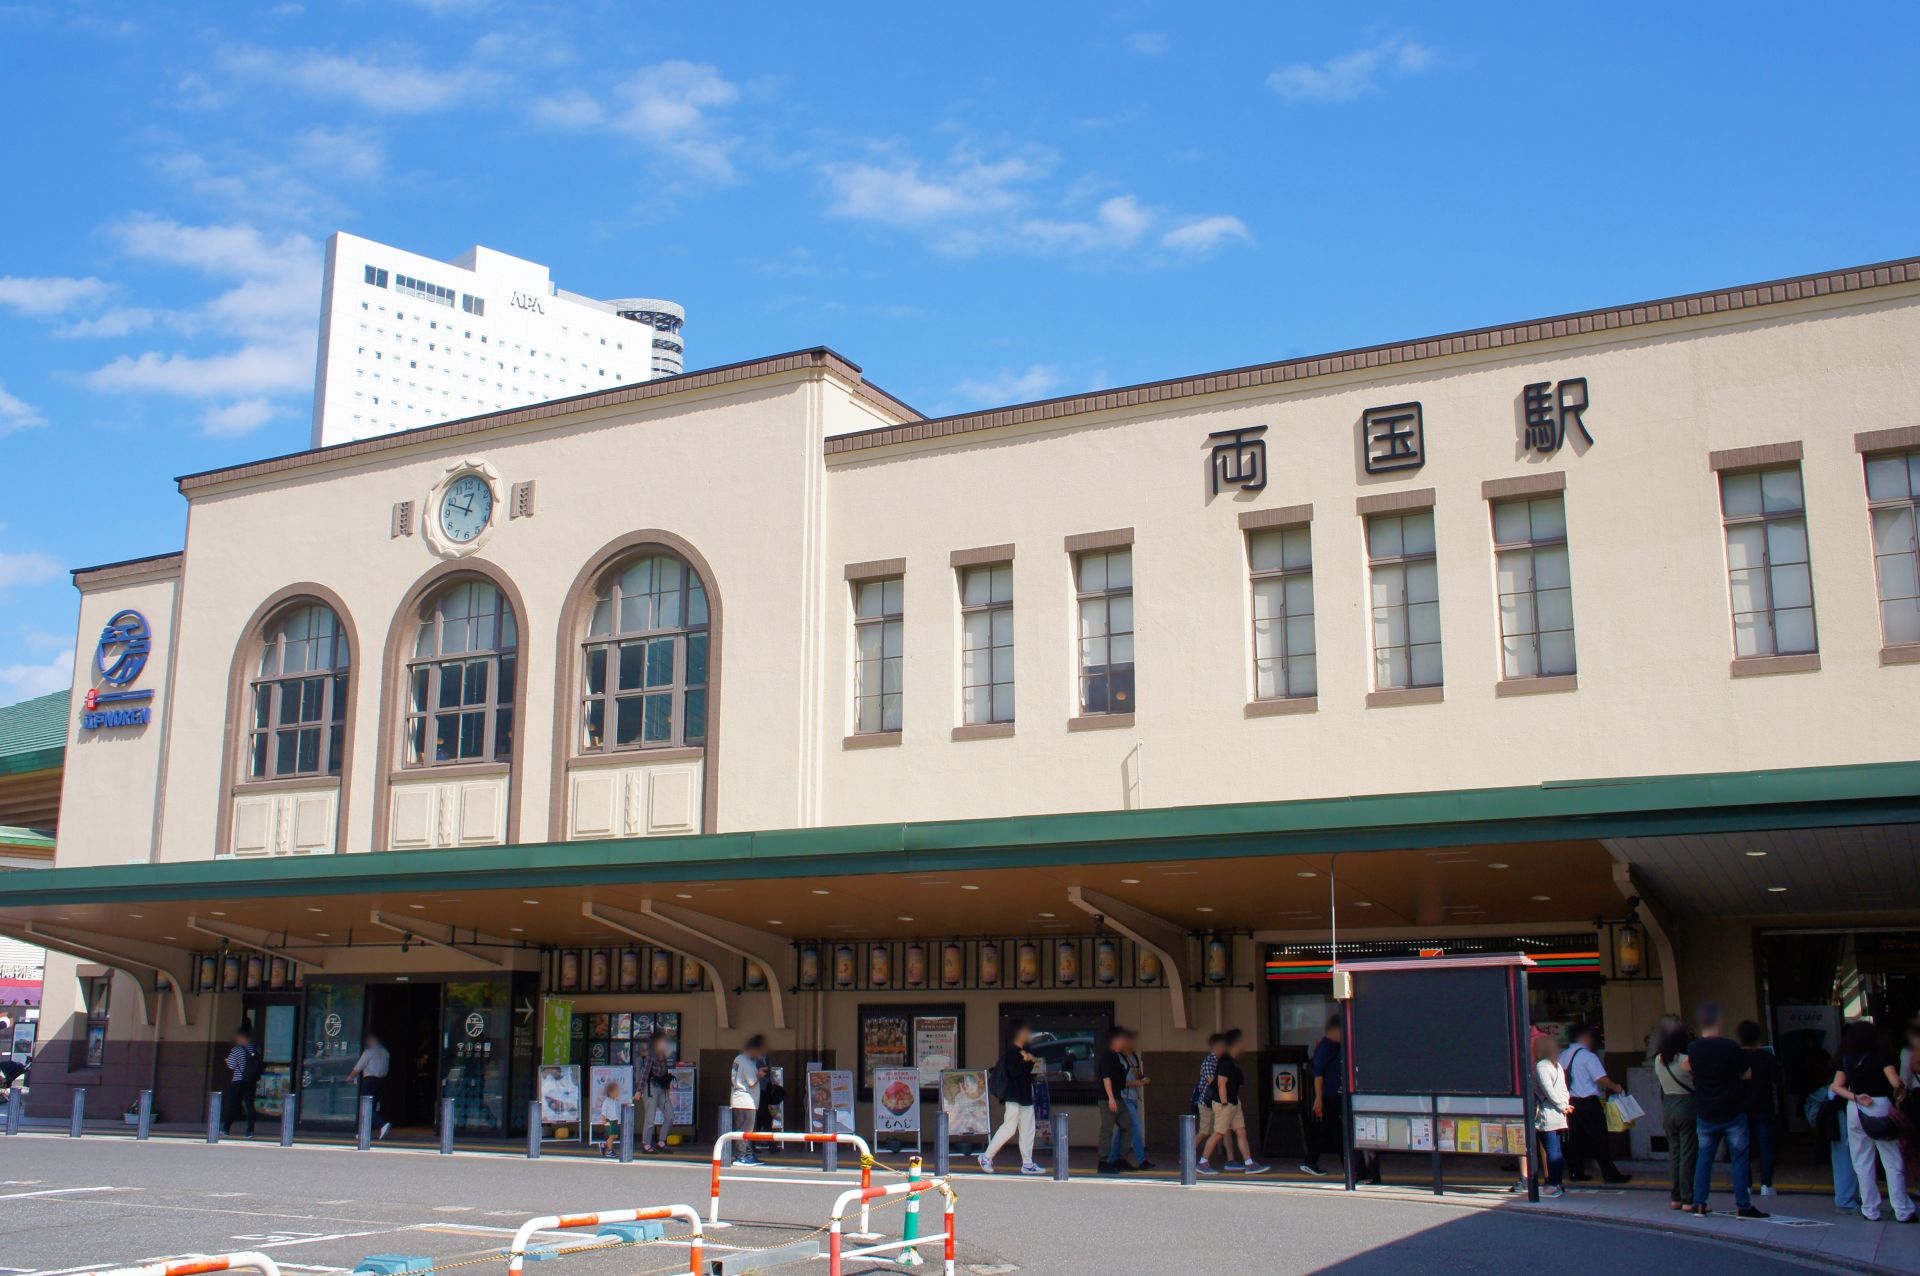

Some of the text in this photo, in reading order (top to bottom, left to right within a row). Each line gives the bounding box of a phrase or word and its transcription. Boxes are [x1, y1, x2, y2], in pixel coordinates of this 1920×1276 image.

[510, 290, 545, 315] APA
[1208, 376, 1594, 496] 両国駅
[464, 480, 474, 490] 12
[456, 487, 463, 495] 11
[445, 510, 451, 518] 9
[447, 522, 453, 530] 8
[474, 526, 480, 534] 5
[455, 530, 460, 538] 7
